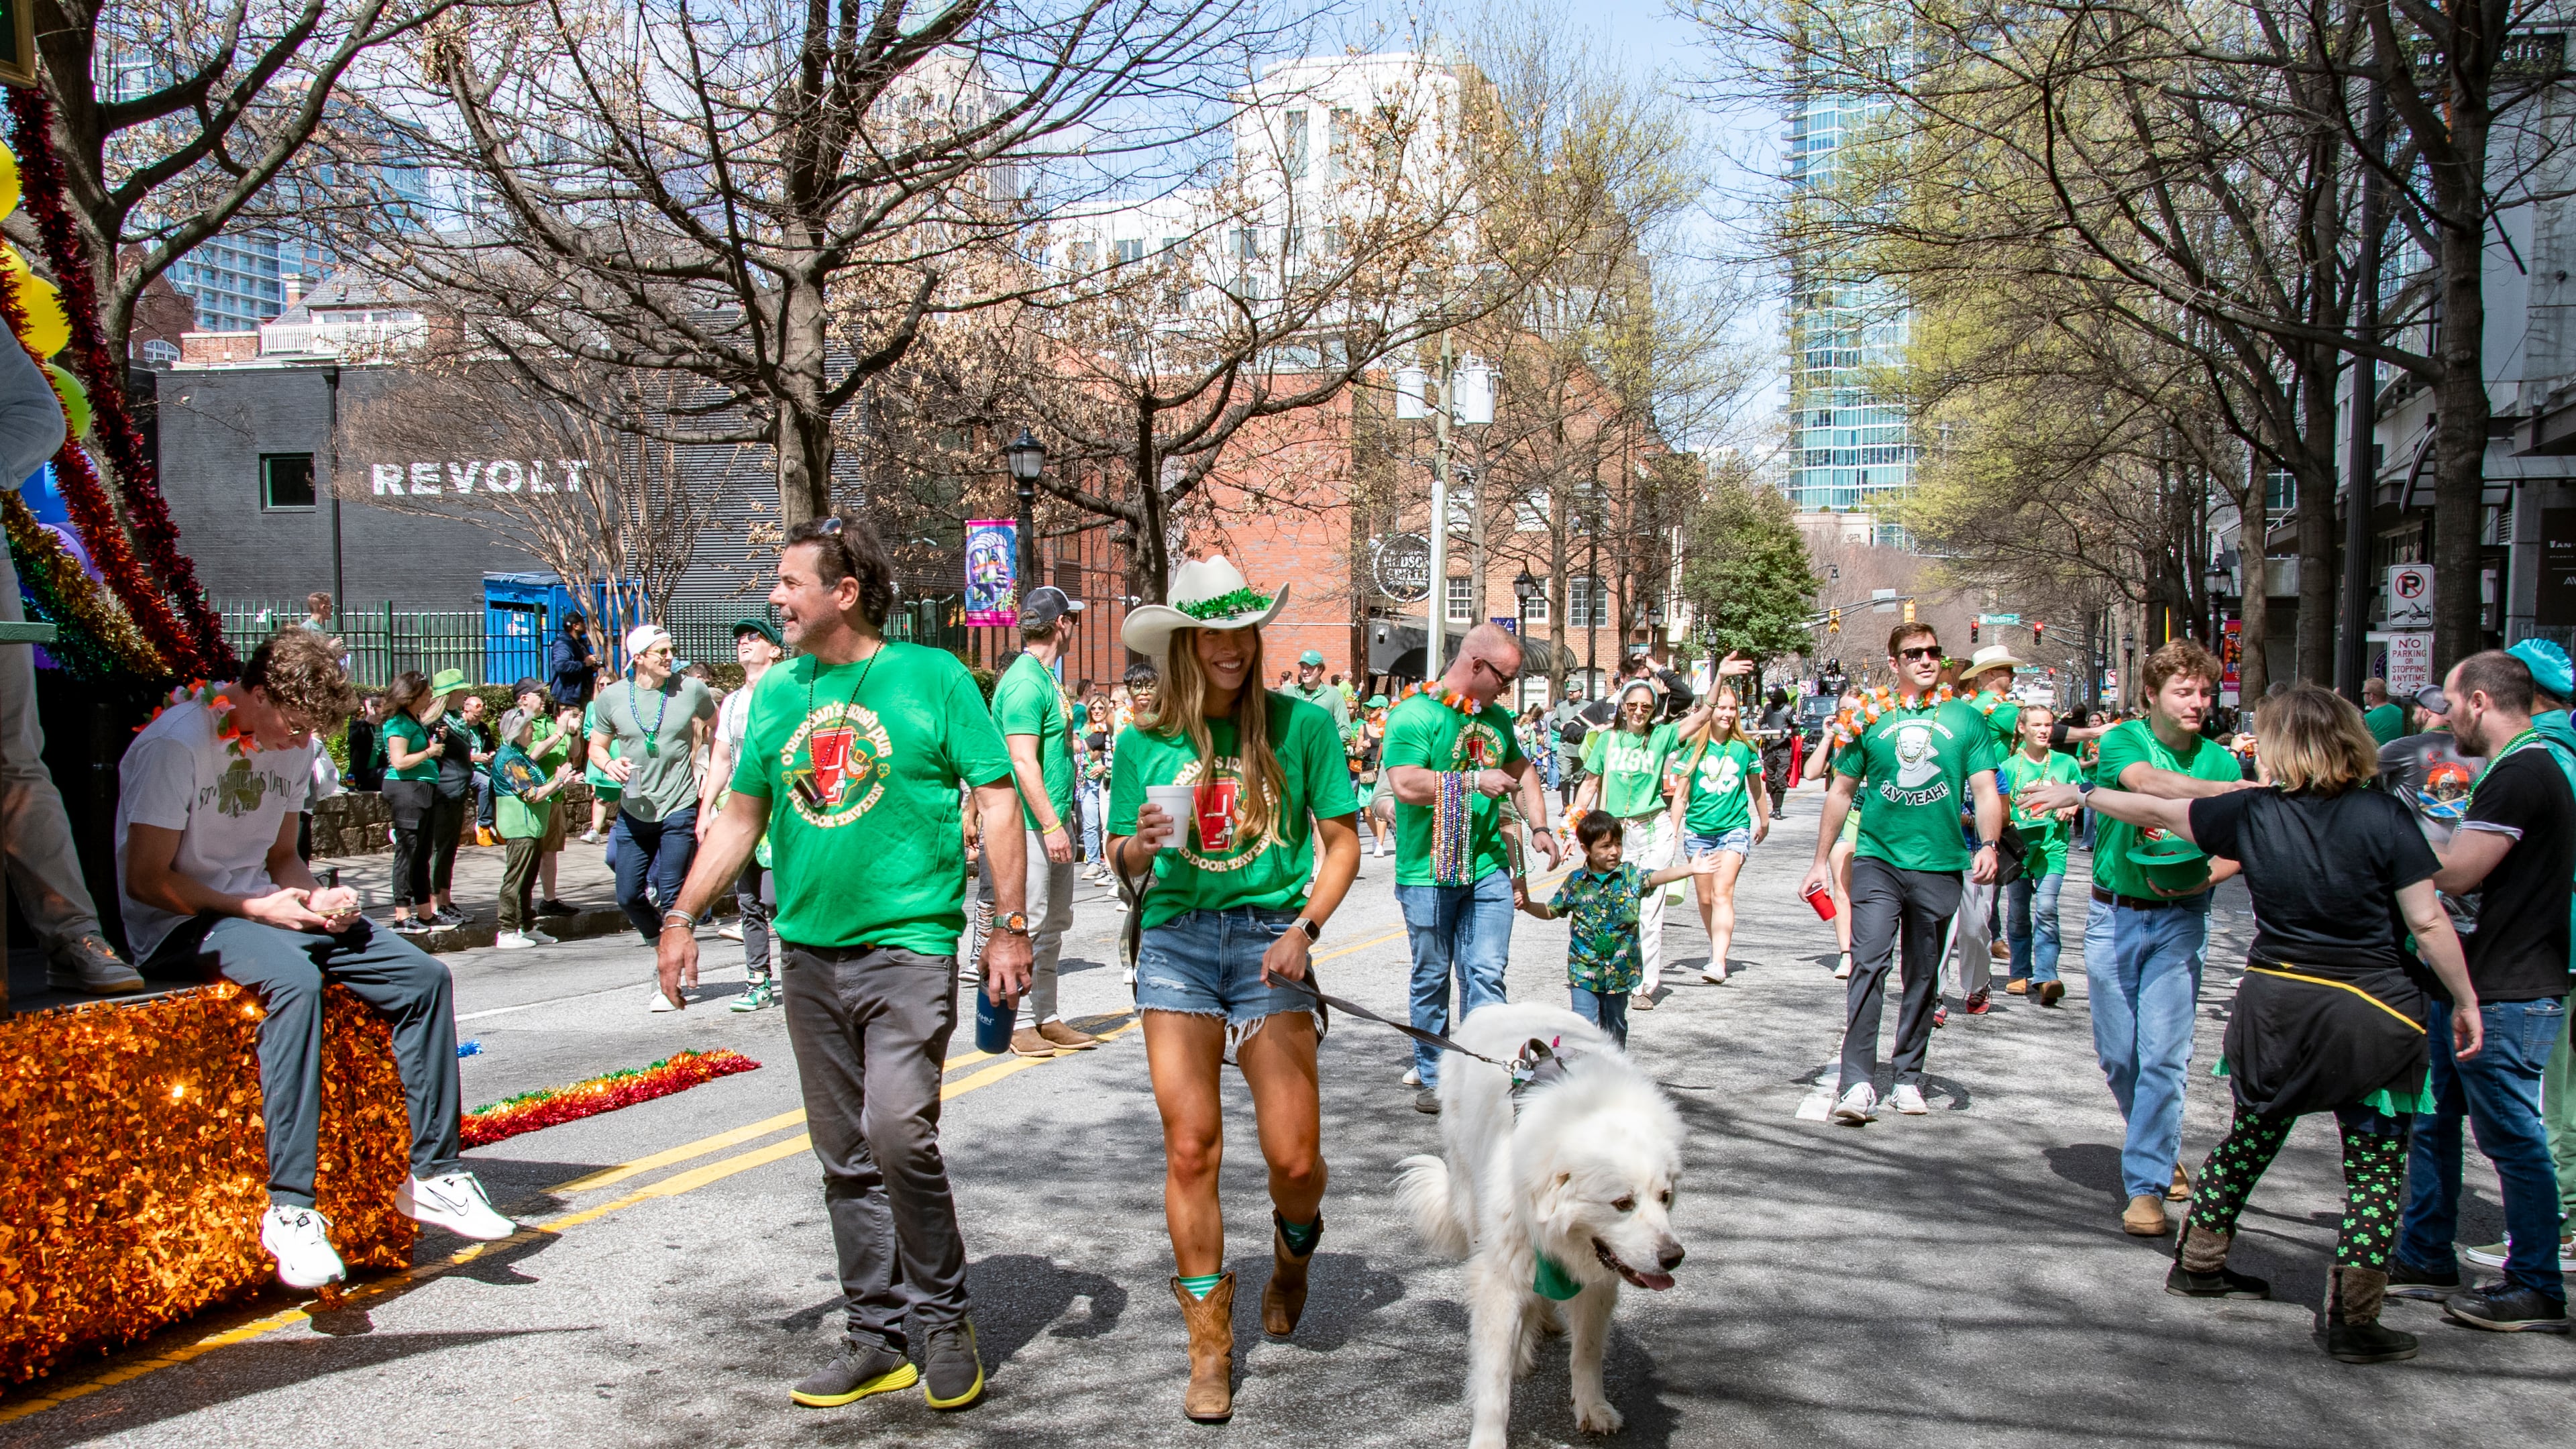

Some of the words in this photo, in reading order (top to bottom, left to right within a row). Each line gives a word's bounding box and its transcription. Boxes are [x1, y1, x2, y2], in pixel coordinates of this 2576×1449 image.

[372, 460, 589, 495] REVOLT
[2398, 639, 2421, 649] NO
[2392, 649, 2427, 657] PARKING
[2392, 665, 2426, 674] STOPPING
[2392, 674, 2426, 682] ANYTIME
[1608, 747, 1655, 774] RISH
[1880, 781, 1903, 802] SAY
[1905, 782, 1949, 805] YEAH!
[802, 809, 836, 828] DOOR
[835, 782, 885, 826] TAVERN
[1189, 855, 1228, 872] DOOR
